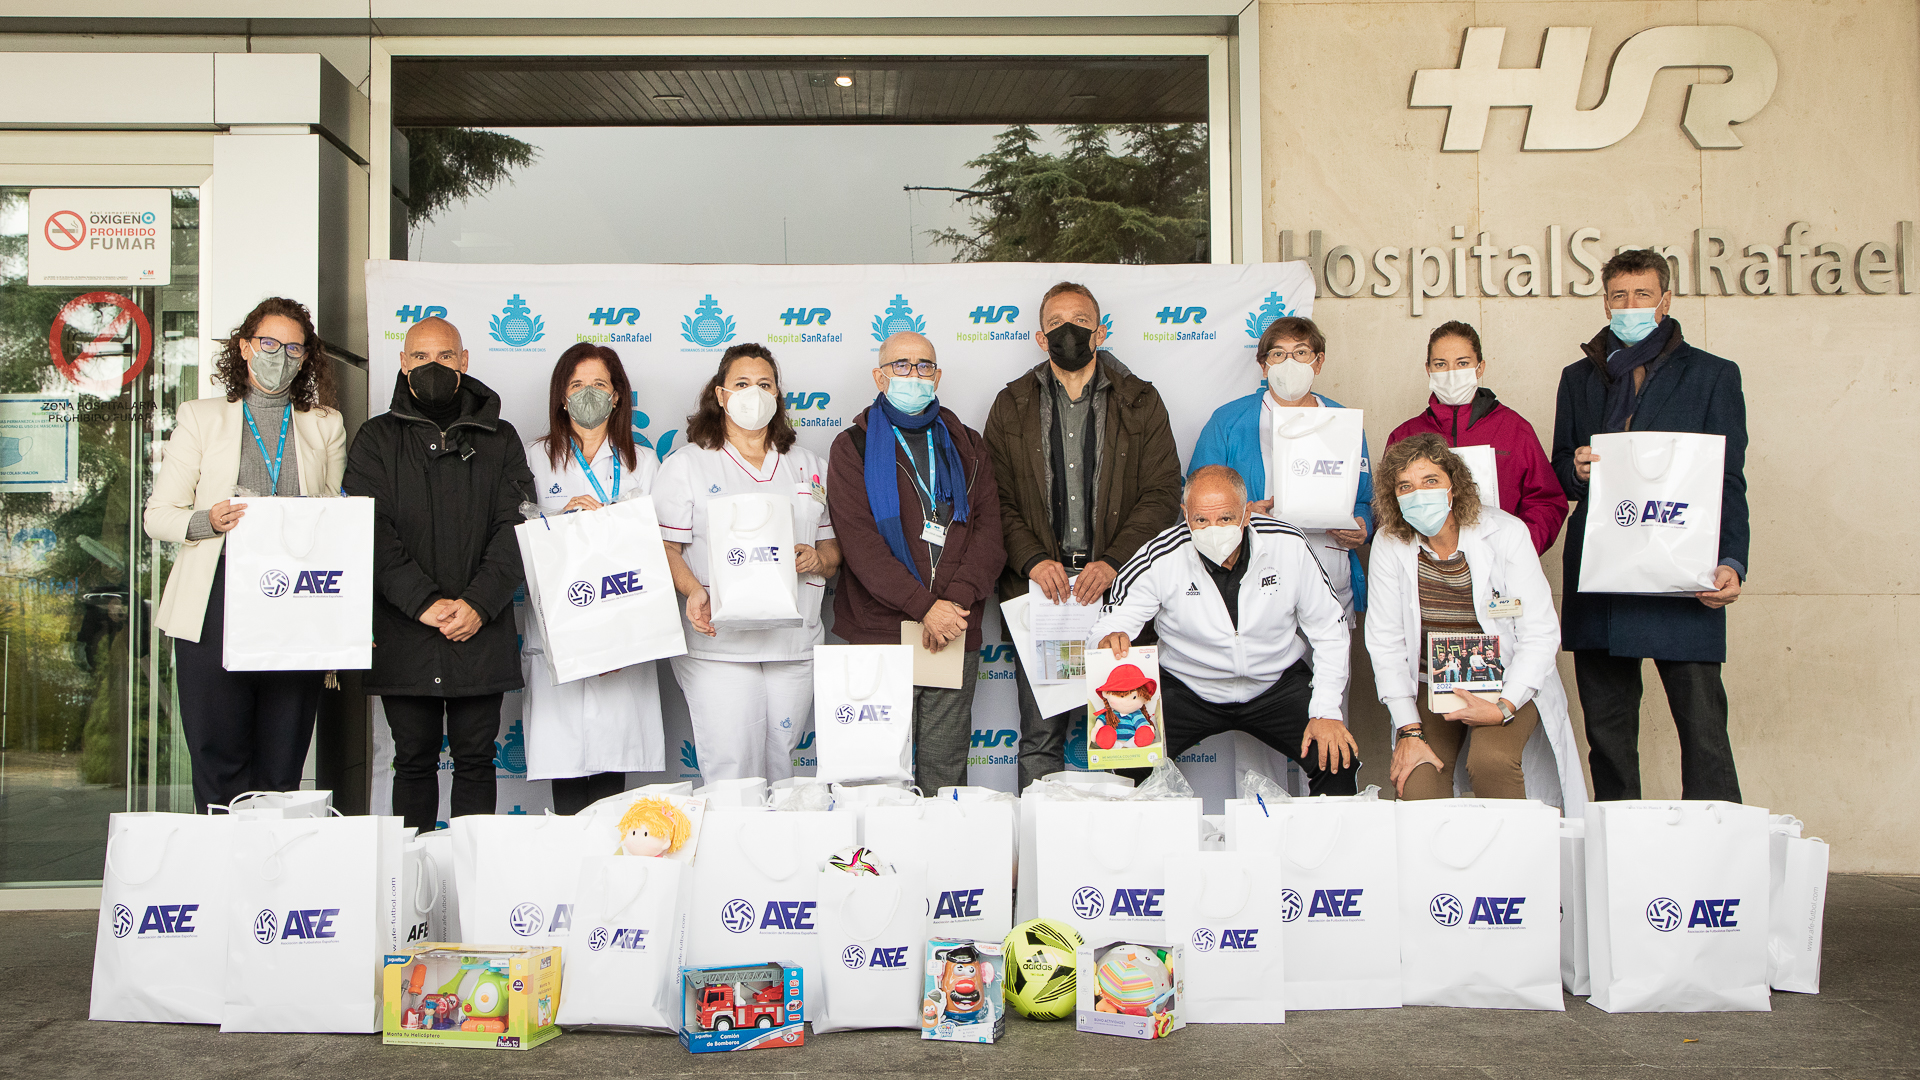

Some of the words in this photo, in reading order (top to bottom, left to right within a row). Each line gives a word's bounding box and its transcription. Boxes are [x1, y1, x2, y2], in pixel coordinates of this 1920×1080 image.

[90, 228, 156, 236] PROHIBIDO
[90, 237, 156, 250] FUMAR
[1278, 220, 1916, 317] HospitalSnRafael
[576, 332, 652, 344] HospitalSanRafael
[767, 332, 843, 344] HospitalSanRafael
[956, 329, 1030, 343] HospitalSanRafael
[1143, 329, 1217, 343] HospitalSanRafael
[43, 402, 74, 410] ZONA
[77, 401, 158, 410] HOSPITALARIA
[48, 414, 110, 423] PROHIBIDO
[1312, 460, 1344, 476] AFE
[1640, 500, 1689, 525] AFE
[748, 546, 780, 563] AFE
[293, 570, 344, 594] AFE
[600, 568, 644, 600] AFE
[1261, 574, 1277, 588] AFE
[858, 704, 892, 722] AFE
[934, 888, 984, 920] AFE
[1109, 888, 1165, 916] AFE
[1308, 888, 1364, 918] AFE
[1468, 896, 1526, 924] AFE
[1688, 898, 1741, 928] AFE
[138, 904, 200, 934] AFE
[280, 908, 340, 940] AFE
[759, 901, 817, 930] AFE
[1806, 886, 1819, 952] www.afe-futbol.com
[407, 921, 429, 943] AFE
[609, 928, 650, 950] AFE
[1219, 929, 1258, 949] AFE
[868, 946, 908, 968] AFE
[1022, 963, 1053, 971] adidas
